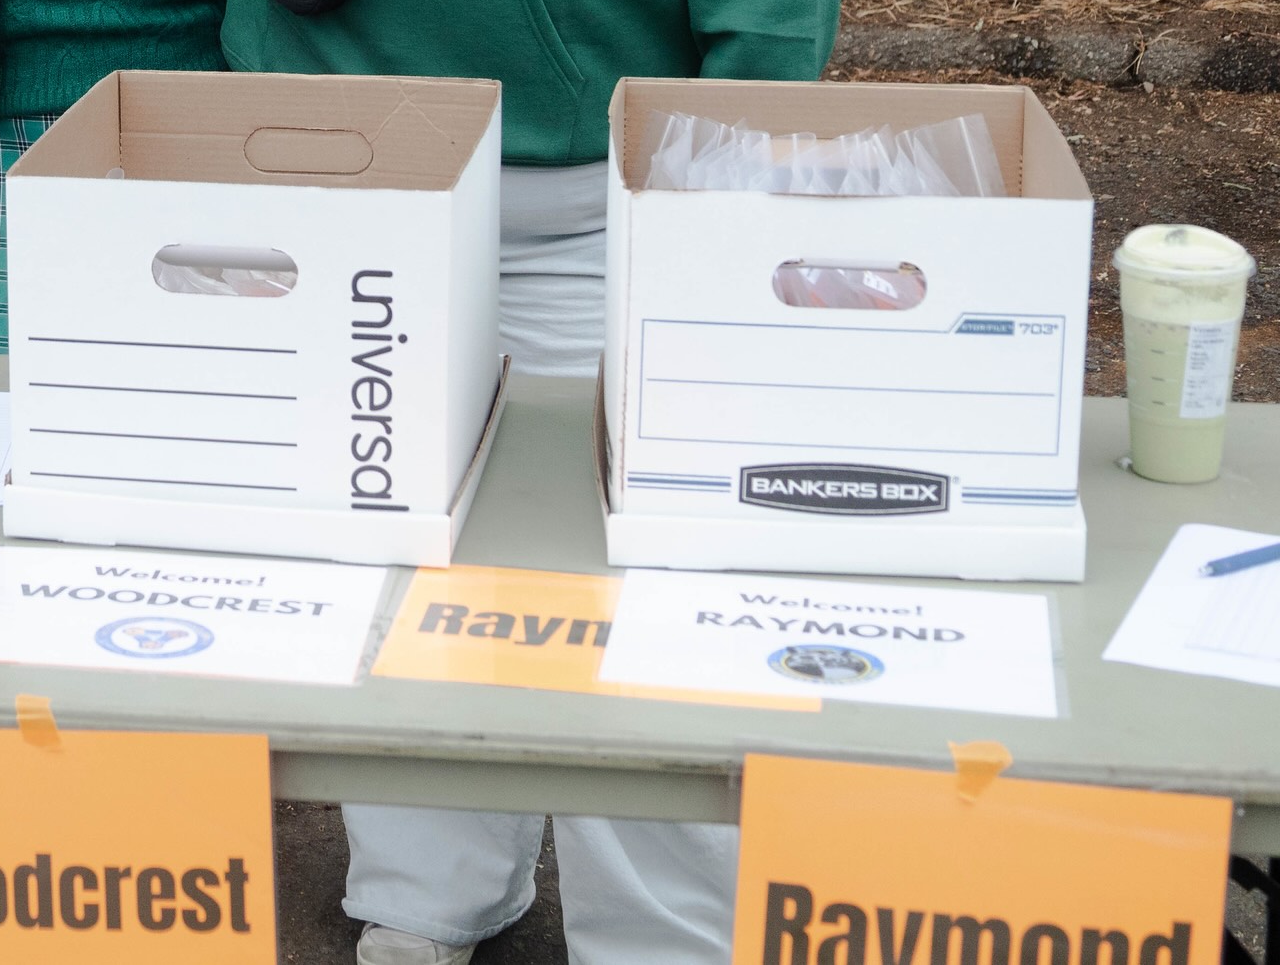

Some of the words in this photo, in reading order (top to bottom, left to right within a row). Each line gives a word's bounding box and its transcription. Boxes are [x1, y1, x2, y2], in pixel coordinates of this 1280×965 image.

[350, 269, 410, 513] universal
[750, 477, 878, 499] BANKERS
[880, 483, 940, 502] BOX
[95, 566, 267, 587] Welcome!
[20, 583, 335, 616] WOODCREST
[739, 593, 924, 616] Welcome!
[695, 610, 967, 642] RAYMOND
